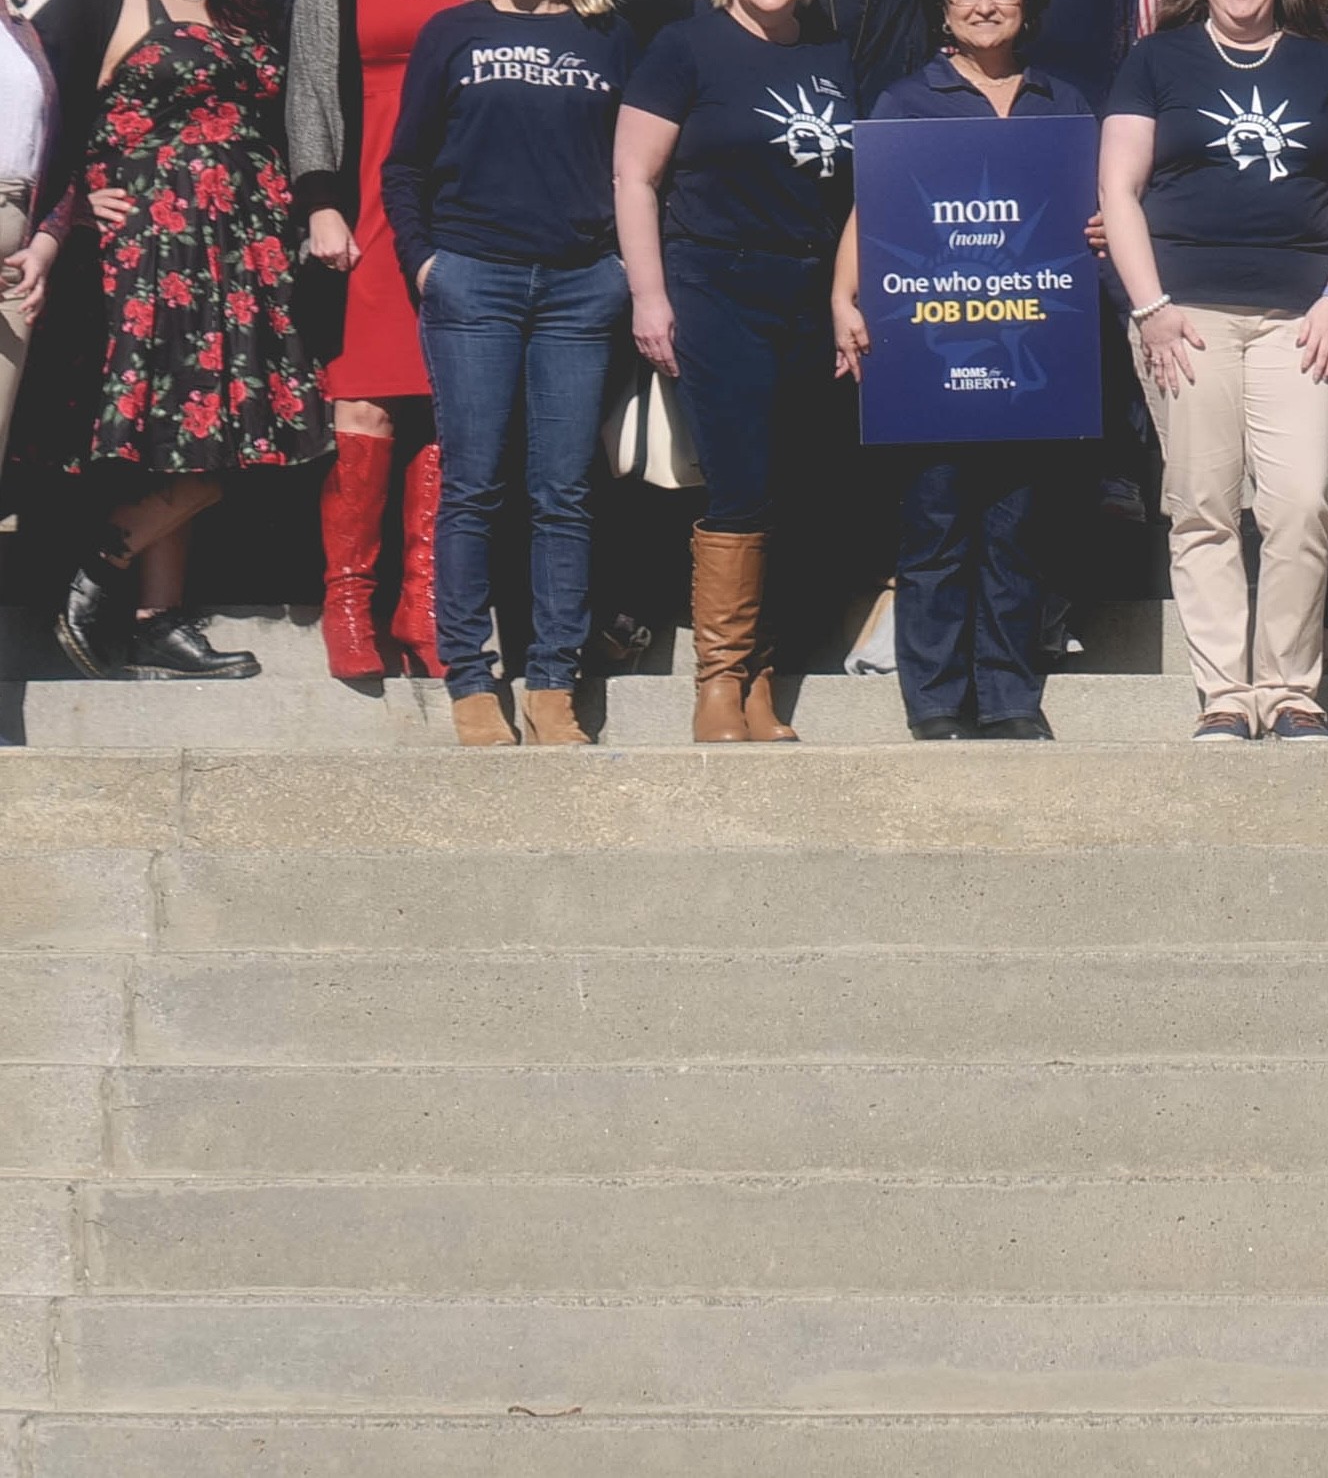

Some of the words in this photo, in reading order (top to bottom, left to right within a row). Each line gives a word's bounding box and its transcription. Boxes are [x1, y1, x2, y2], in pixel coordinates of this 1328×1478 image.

[472, 46, 551, 66] MOMS
[551, 52, 587, 69] for
[473, 63, 601, 91] LIBERTY
[932, 199, 1020, 223] mom
[948, 229, 1006, 249] (noun)
[883, 273, 928, 294] One
[933, 271, 981, 292] who
[986, 272, 1032, 296] gets
[1037, 269, 1073, 290] the
[911, 300, 961, 324] JOB
[965, 299, 1047, 322] DONE.
[950, 367, 987, 379] MOMS
[987, 366, 1001, 379] for
[952, 378, 1010, 391] LIBERTY
